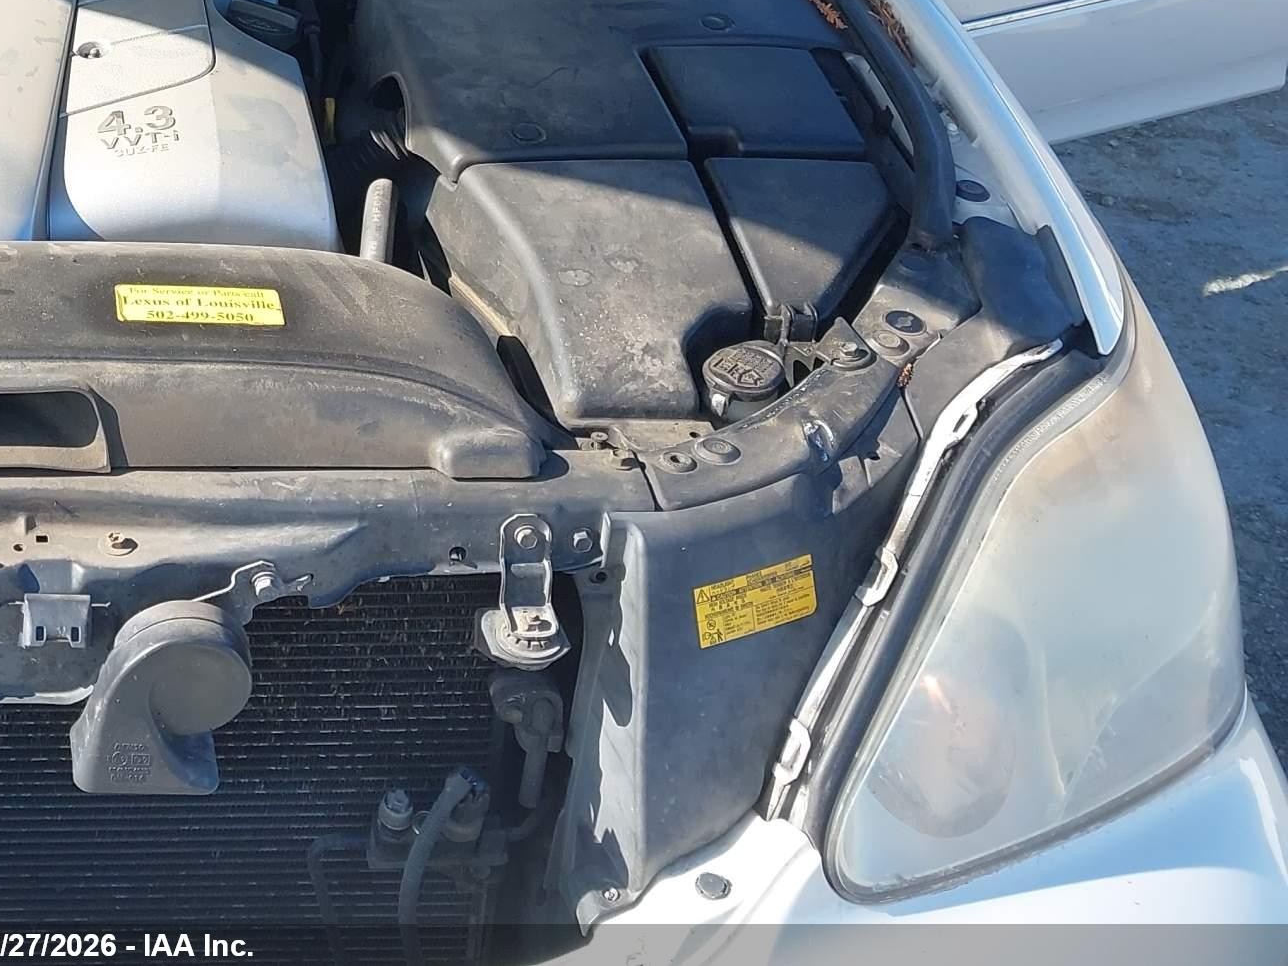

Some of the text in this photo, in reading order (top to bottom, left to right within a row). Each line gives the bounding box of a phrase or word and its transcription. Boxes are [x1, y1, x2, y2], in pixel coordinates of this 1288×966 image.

[97, 105, 176, 135] 4.3
[152, 287, 193, 295] Service
[122, 296, 275, 309] Lexus of Louisville
[146, 310, 255, 322] 502-499-5050
